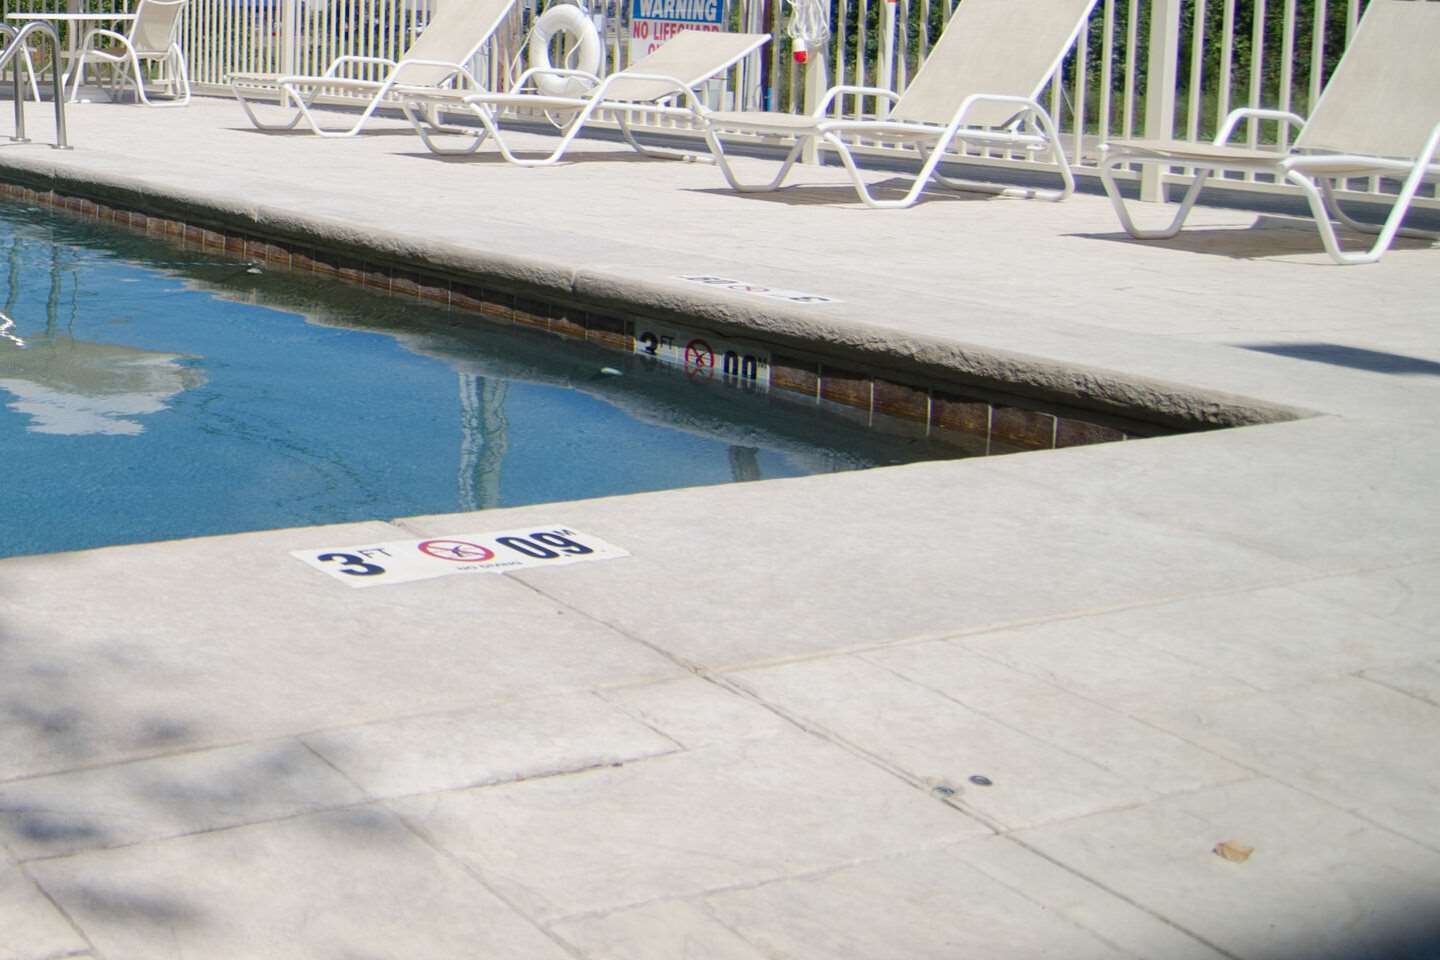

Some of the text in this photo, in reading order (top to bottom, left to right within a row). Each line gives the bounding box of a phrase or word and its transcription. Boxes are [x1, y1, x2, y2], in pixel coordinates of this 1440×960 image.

[633, 21, 649, 39] NO
[317, 552, 387, 577] 3
[357, 547, 393, 560] FT
